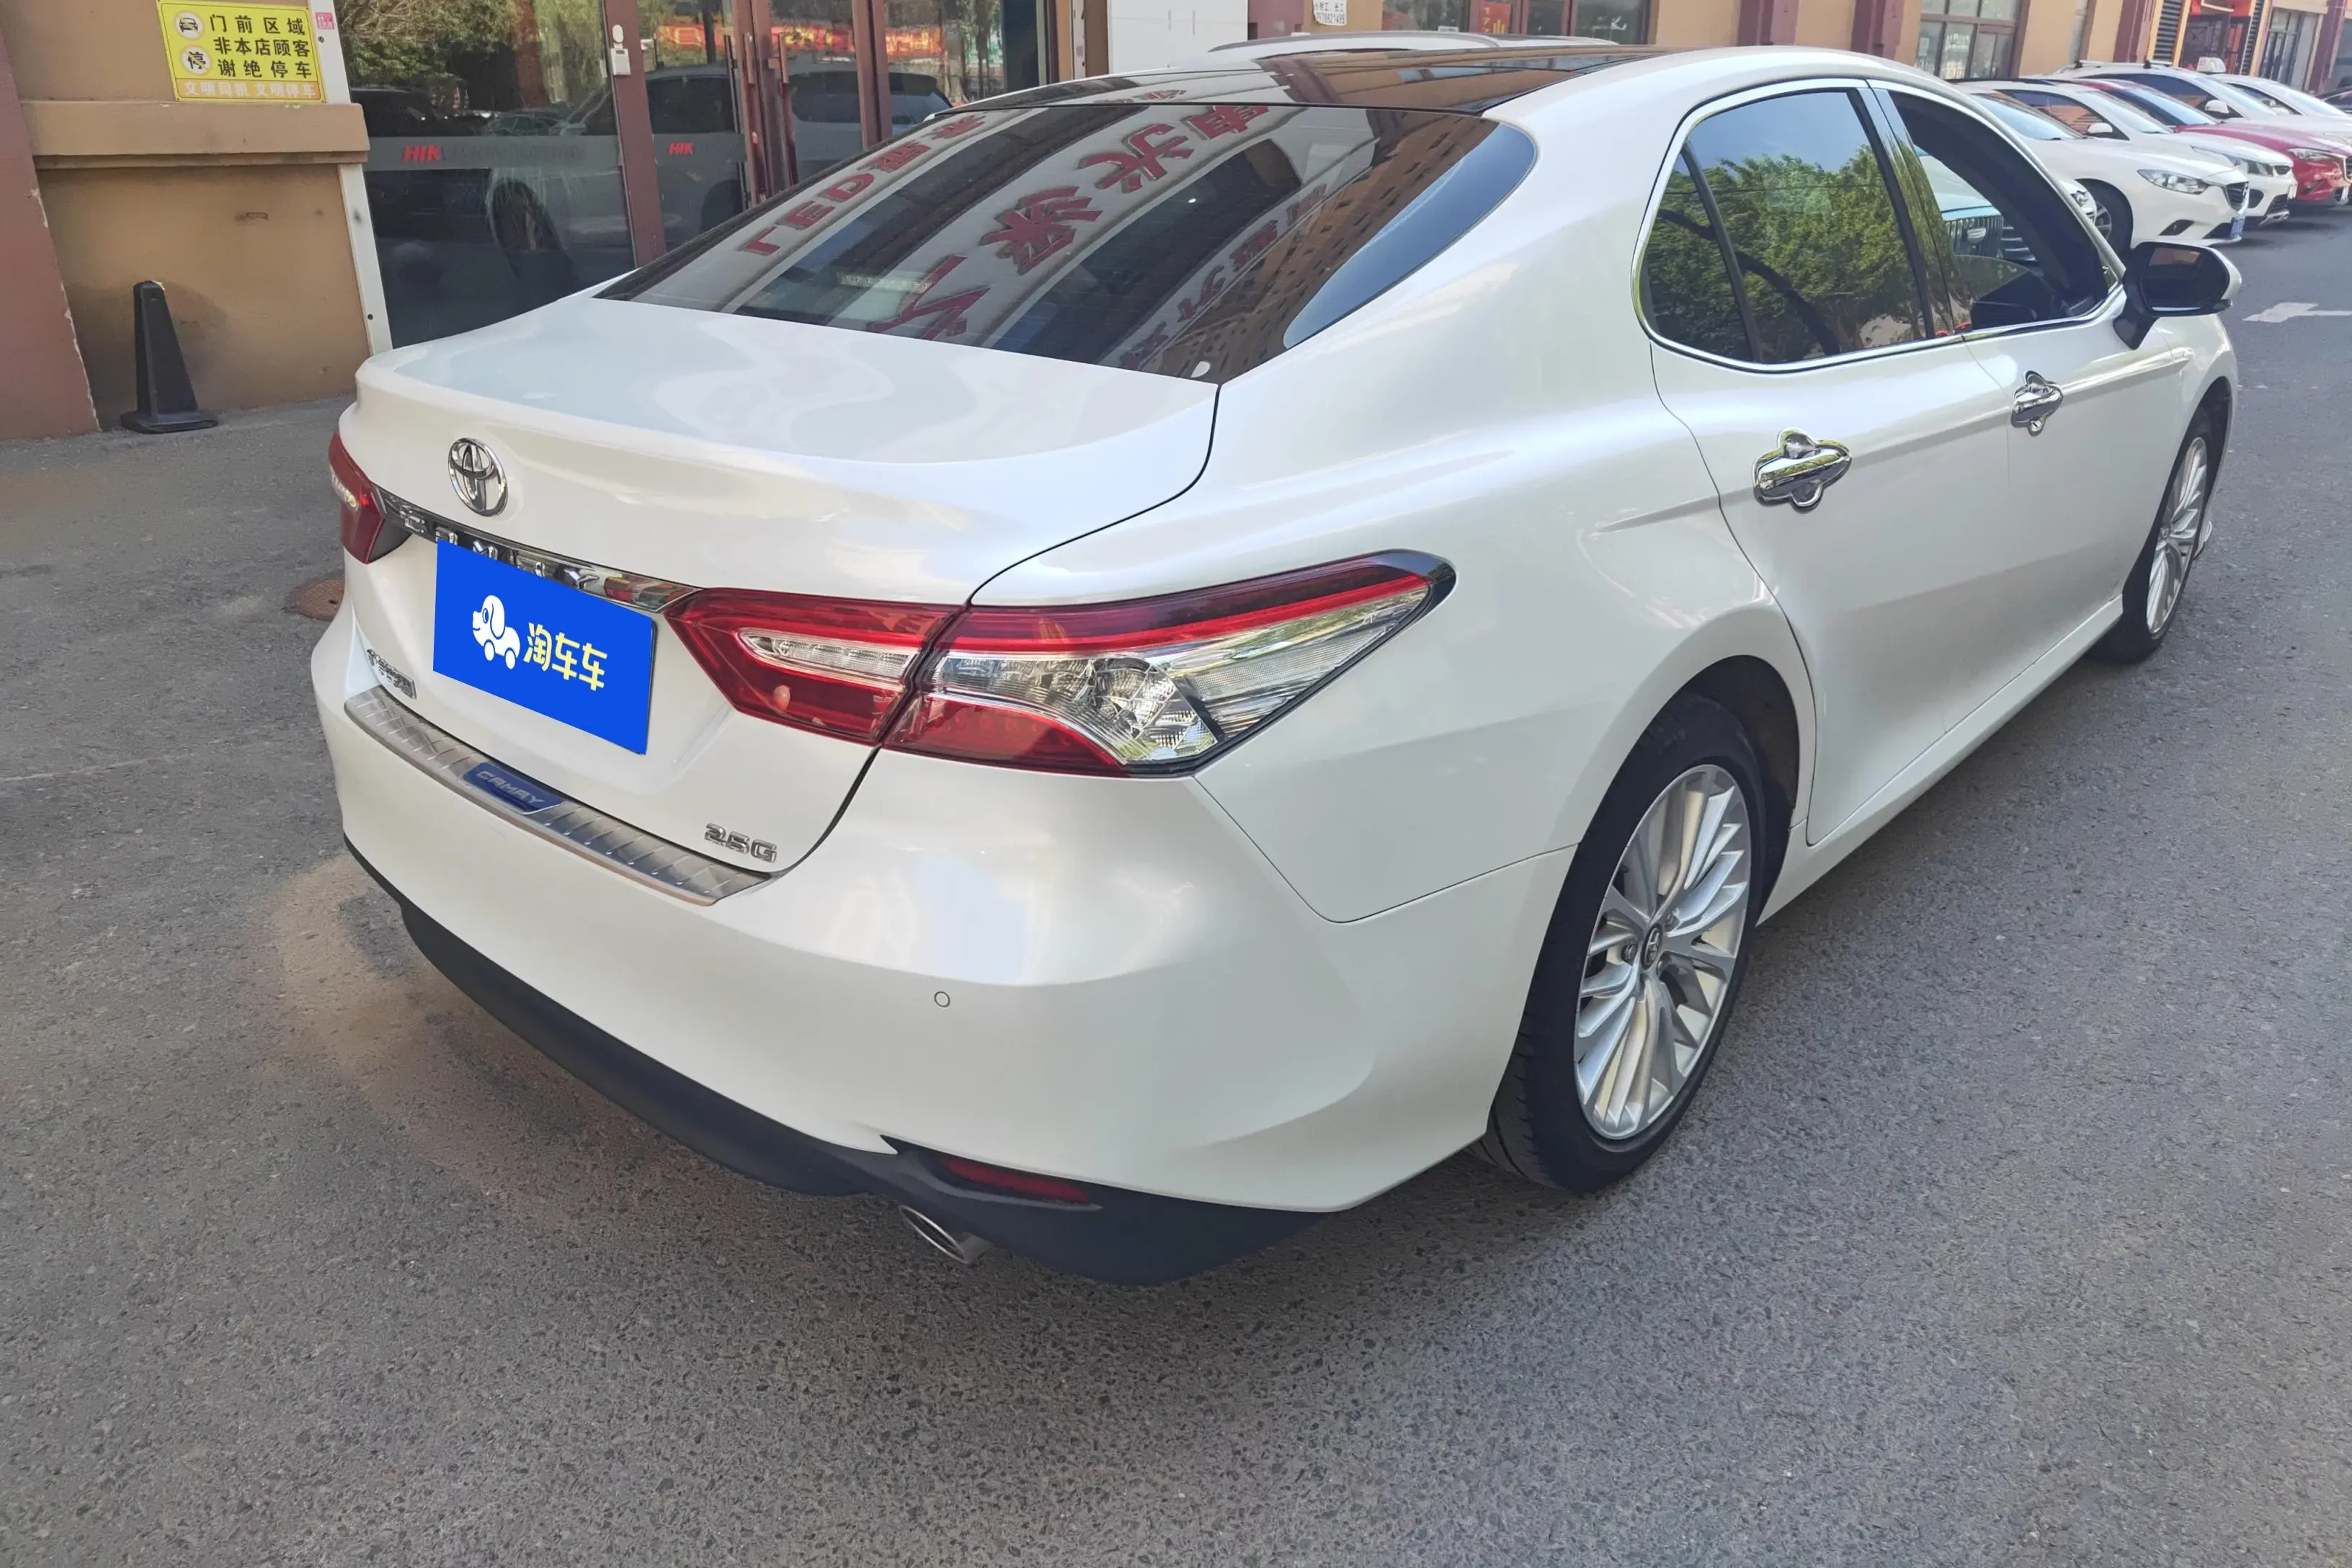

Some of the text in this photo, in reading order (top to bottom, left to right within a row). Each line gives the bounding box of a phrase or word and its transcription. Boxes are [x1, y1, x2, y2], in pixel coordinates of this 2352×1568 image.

[210, 14, 306, 35] 门前区域
[213, 37, 311, 58] 非本店顾客
[218, 59, 312, 79] 谢绝停车
[184, 81, 316, 98] 文明司机 文明停车
[476, 770, 545, 803] CAMRY
